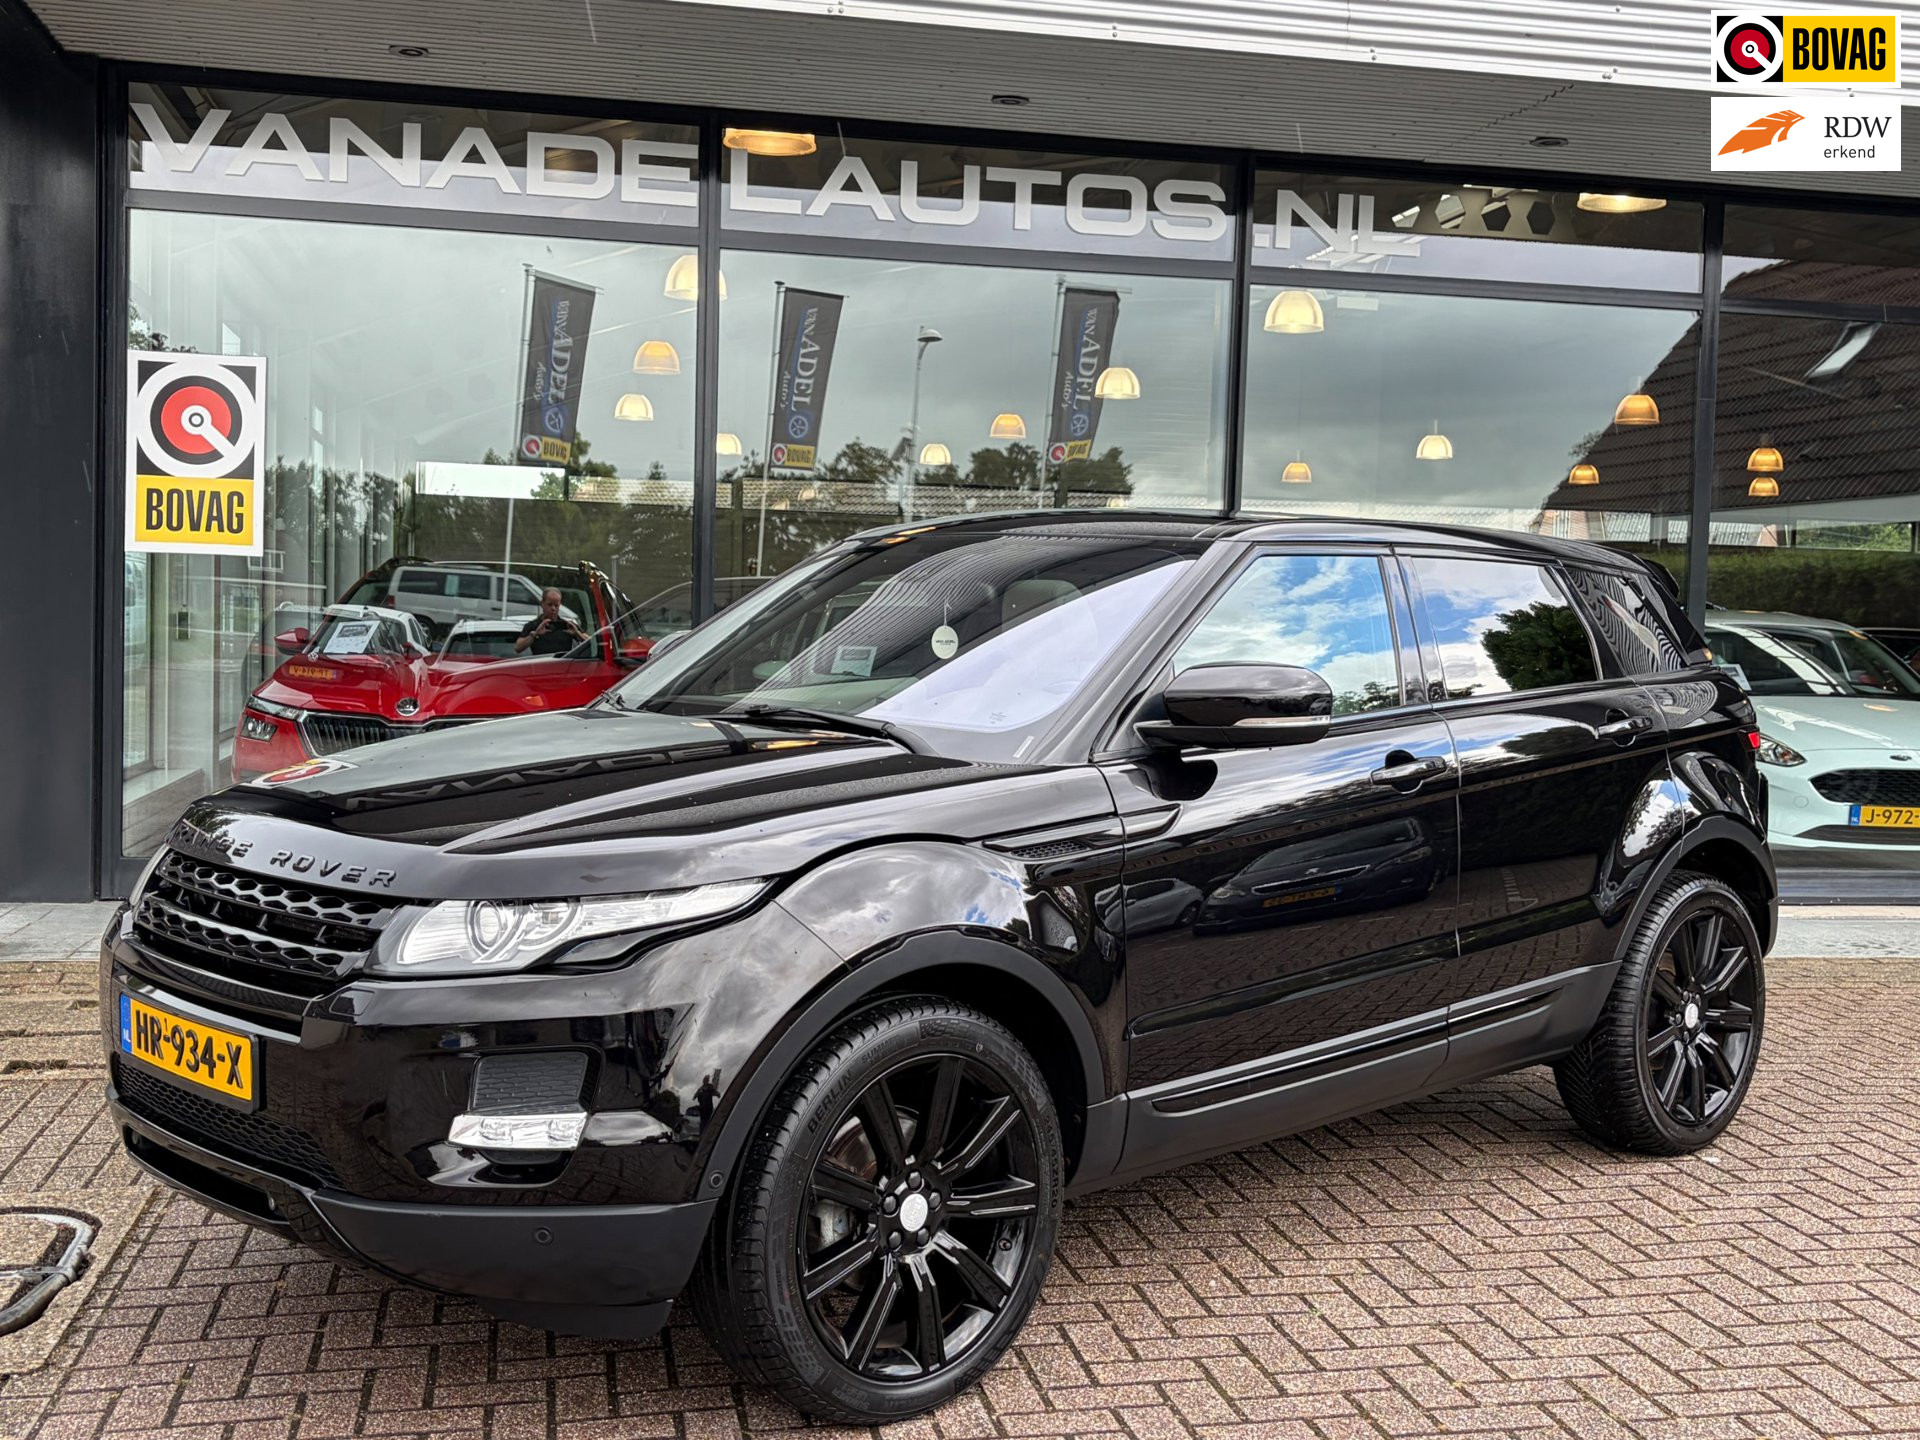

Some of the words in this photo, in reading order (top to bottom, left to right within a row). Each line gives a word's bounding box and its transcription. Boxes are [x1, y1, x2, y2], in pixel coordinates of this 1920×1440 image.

[146, 487, 244, 534] BOVAG
[269, 850, 397, 888] ROVER
[135, 1009, 244, 1090] HR-934-X
[807, 1068, 854, 1135] BERLIN
